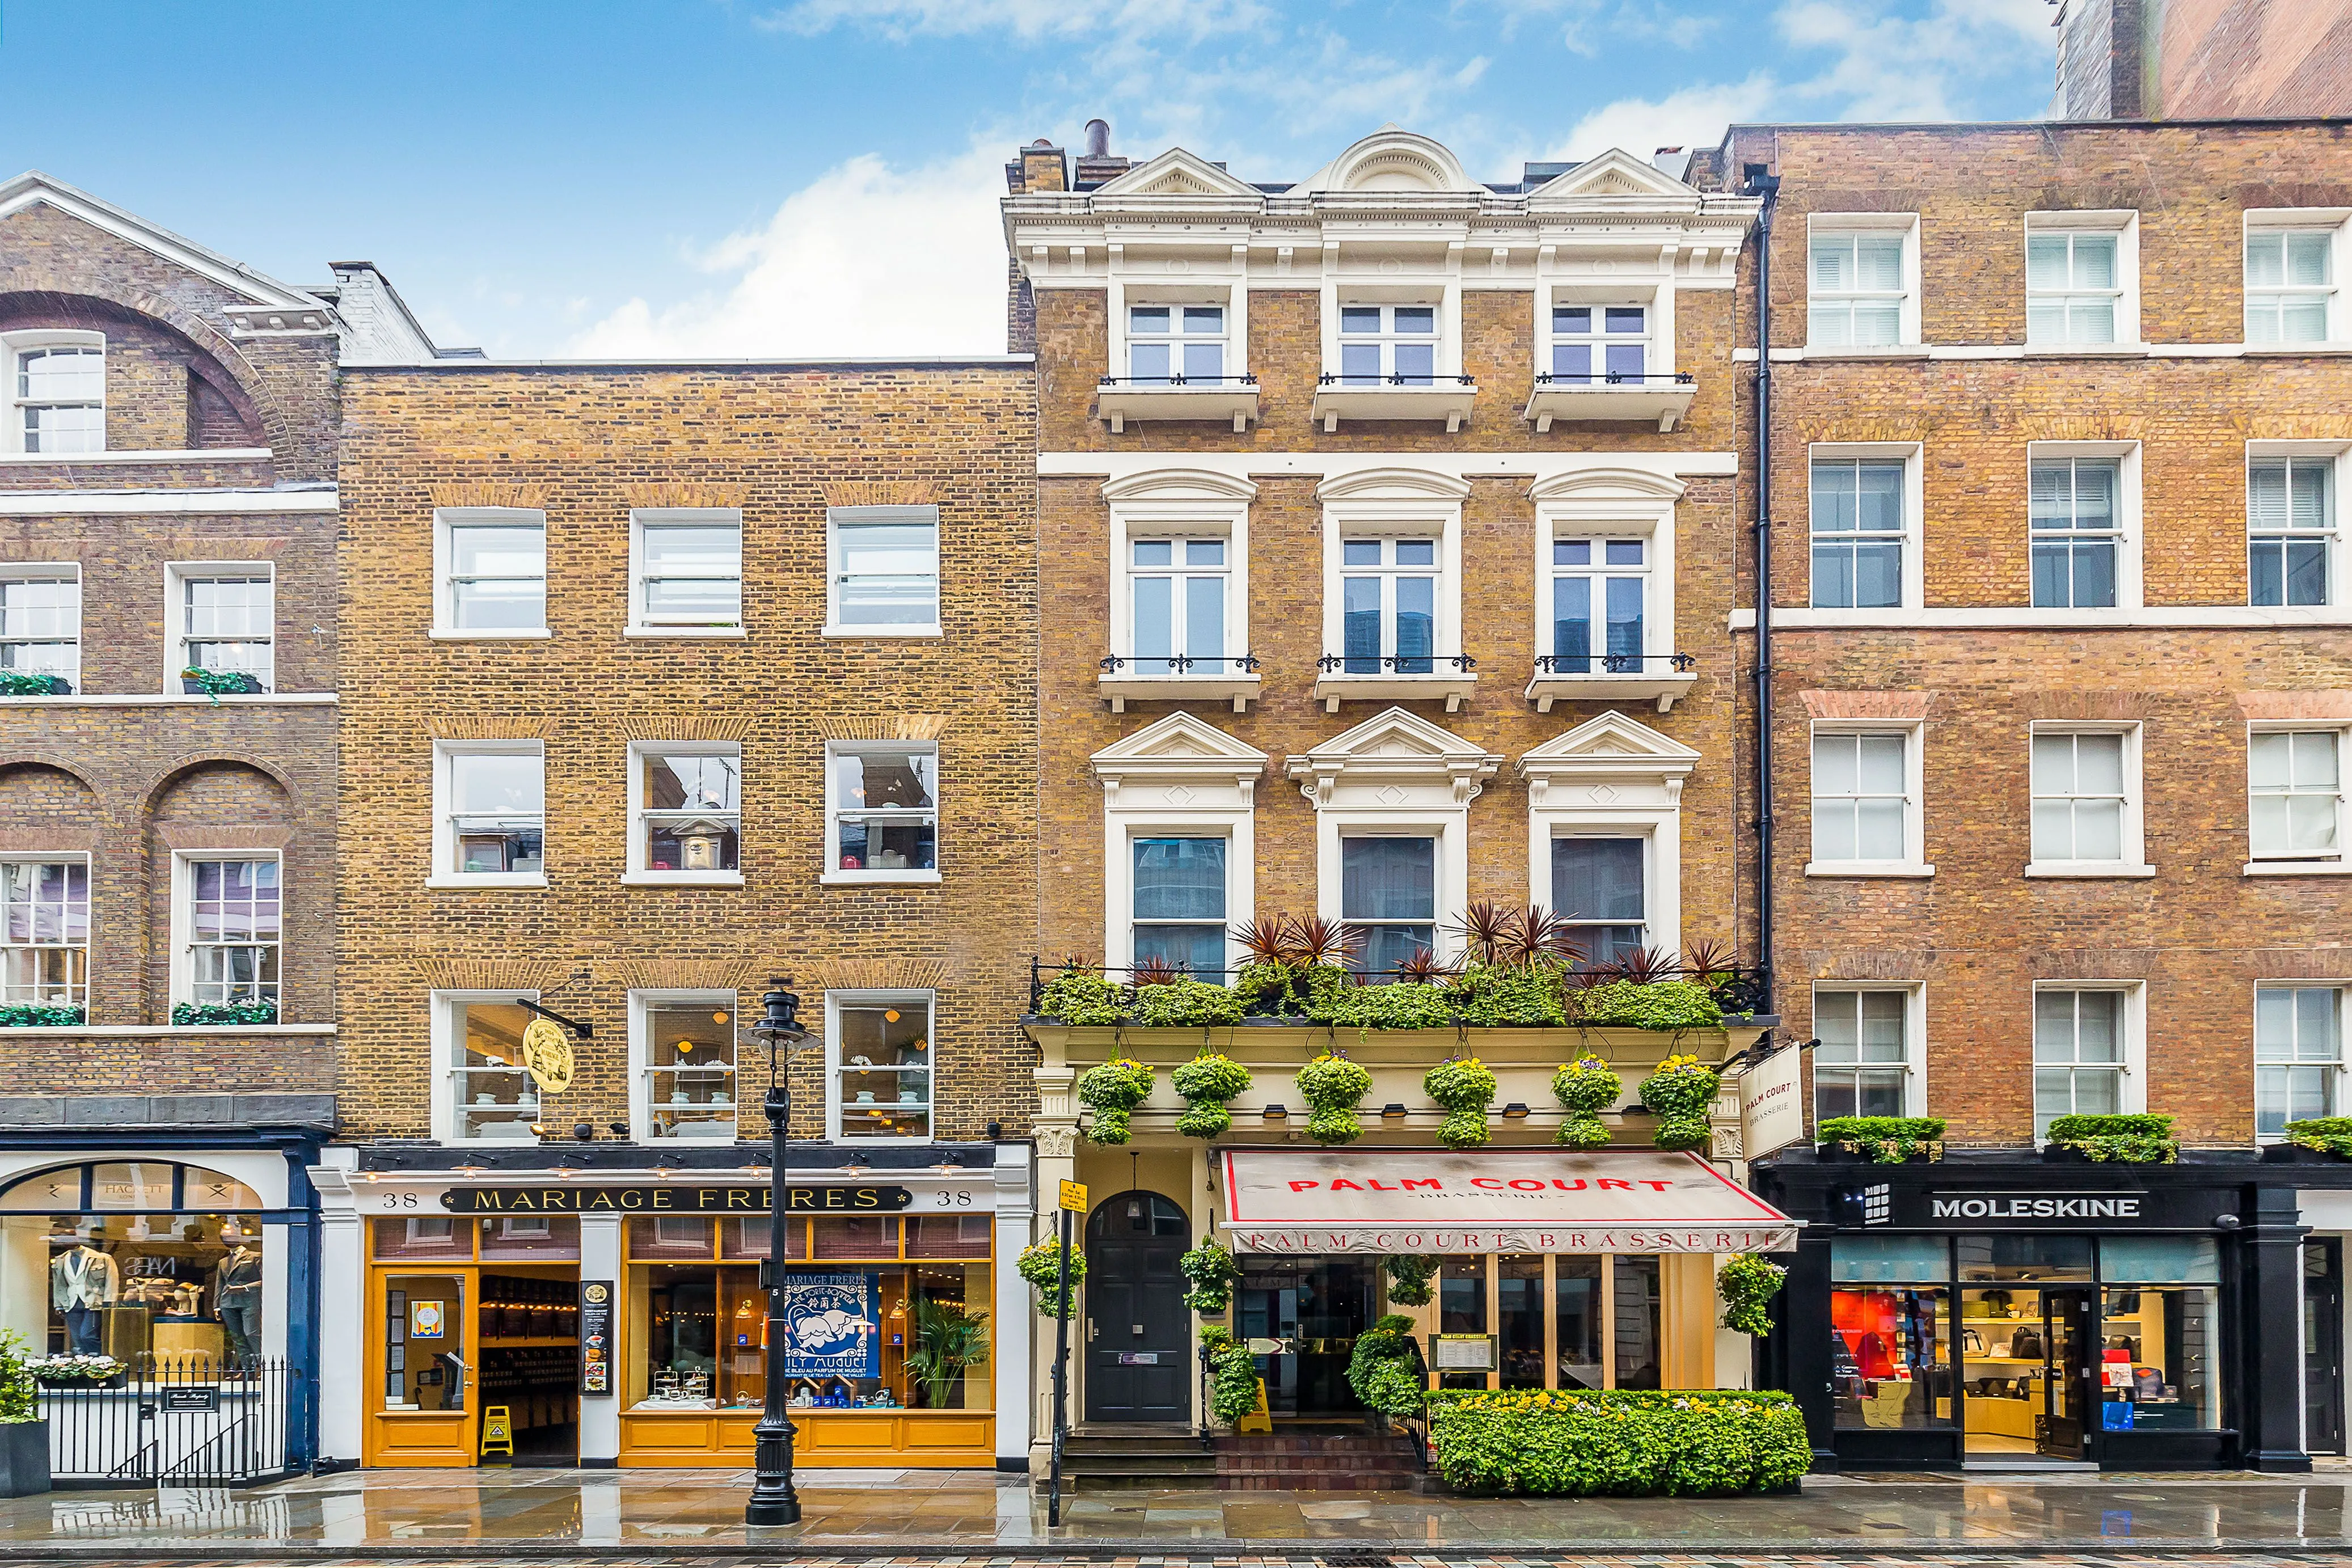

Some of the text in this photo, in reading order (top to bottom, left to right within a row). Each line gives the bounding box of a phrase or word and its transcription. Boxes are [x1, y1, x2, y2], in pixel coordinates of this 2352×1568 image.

[1745, 1083, 1791, 1113] PALM COURT
[1750, 1102, 1789, 1127] BRASSERIE
[105, 1184, 163, 1194] HACETT
[1286, 1177, 1674, 1193] PALM COURT
[383, 1193, 418, 1208] 38
[474, 1189, 673, 1209] MARIAGE
[936, 1190, 972, 1206] 38
[1932, 1198, 2140, 1218] MOLESKINE
[1250, 1232, 1780, 1248] PALM COURT BRASSERIE
[784, 1275, 827, 1285] MARIAGE
[785, 1358, 807, 1367] ILY
